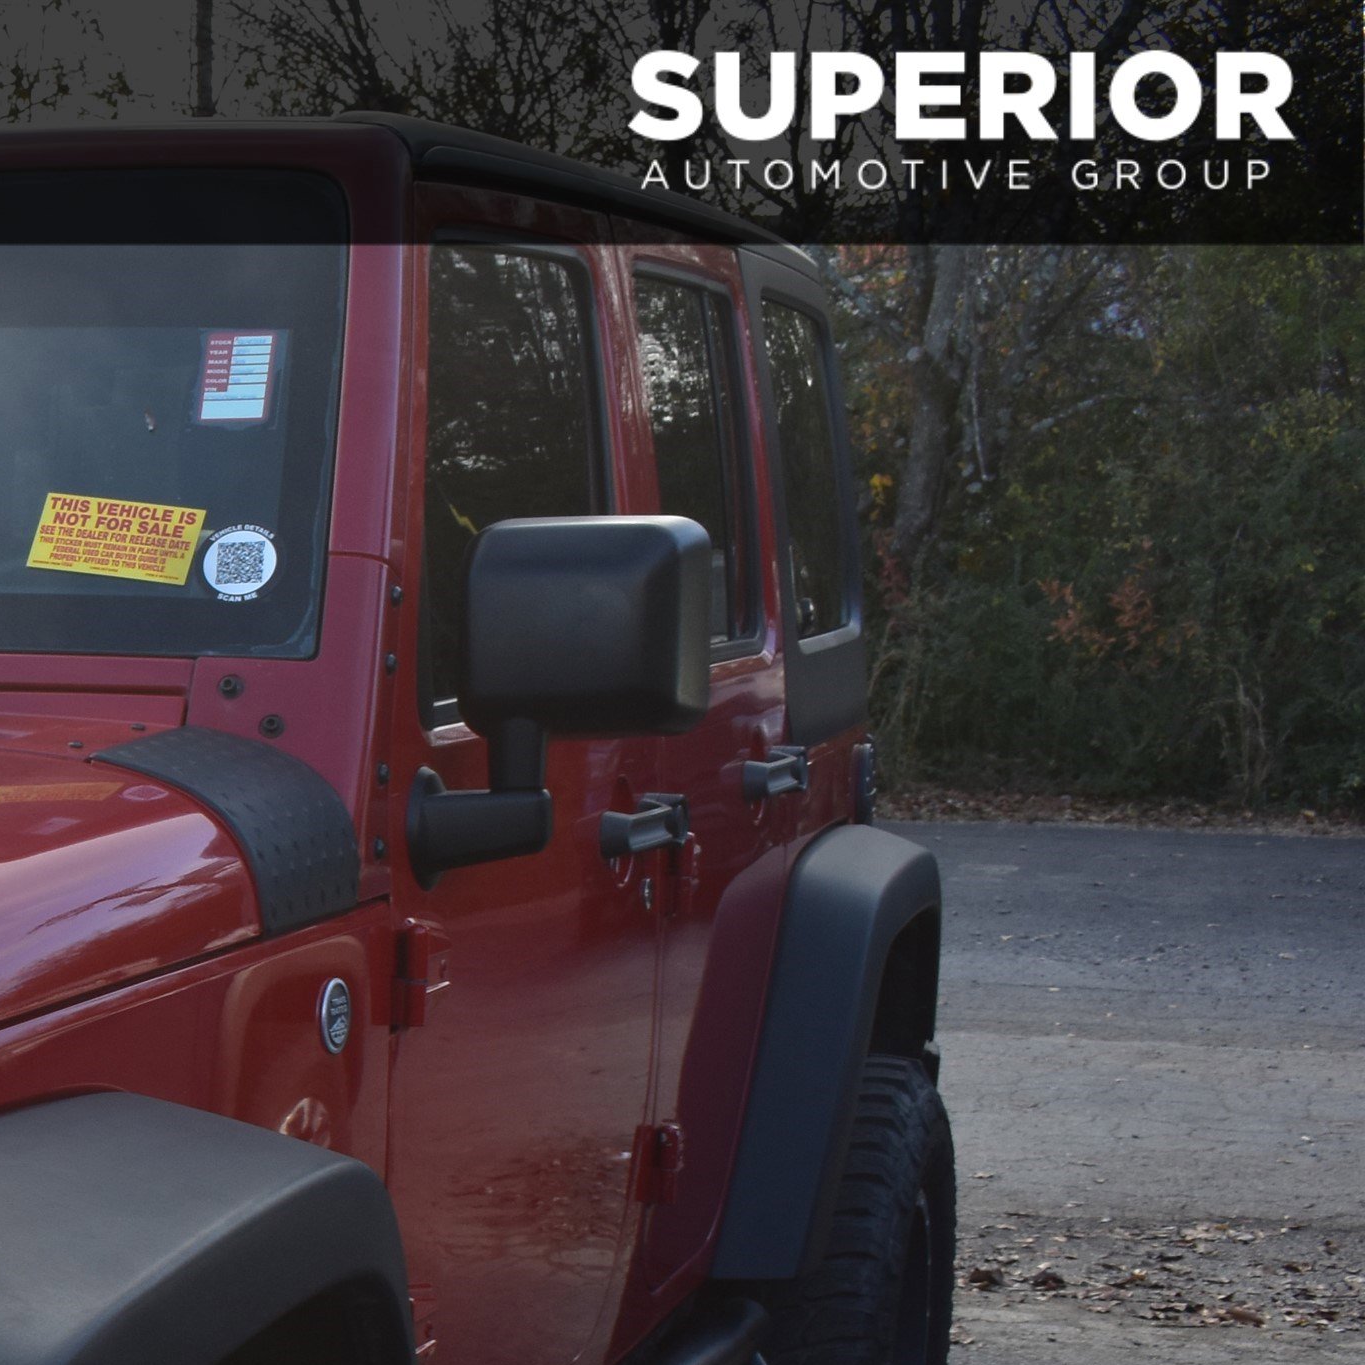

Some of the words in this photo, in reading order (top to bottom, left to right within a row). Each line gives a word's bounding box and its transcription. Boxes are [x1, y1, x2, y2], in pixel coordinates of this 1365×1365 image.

[50, 497, 91, 513] THIS
[97, 502, 174, 522] VEHICLE
[179, 511, 197, 525] IS
[53, 511, 90, 528] NOT
[95, 517, 132, 532] FOR
[137, 521, 185, 538] SALE
[210, 524, 243, 541] VEHICLE
[244, 524, 275, 540] DETAILS
[40, 525, 56, 535] SEE
[58, 527, 74, 537] THE
[76, 529, 109, 541] DEALER
[110, 532, 128, 543] FOR
[129, 535, 167, 548] RELEASE
[168, 540, 191, 551] DATE
[53, 545, 80, 554] FEDERAL
[115, 552, 137, 560] BUYER
[138, 555, 158, 563] GUIDE
[56, 538, 82, 546] STICKER
[103, 543, 127, 551] REMAIN
[137, 547, 158, 555] PLACE
[159, 550, 178, 558] UNTIL
[49, 553, 82, 562] PROPERLY
[83, 557, 110, 565] AFFIXED
[138, 564, 165, 572] VEHICLE
[217, 593, 242, 602] SCAN
[243, 592, 258, 600] ME
